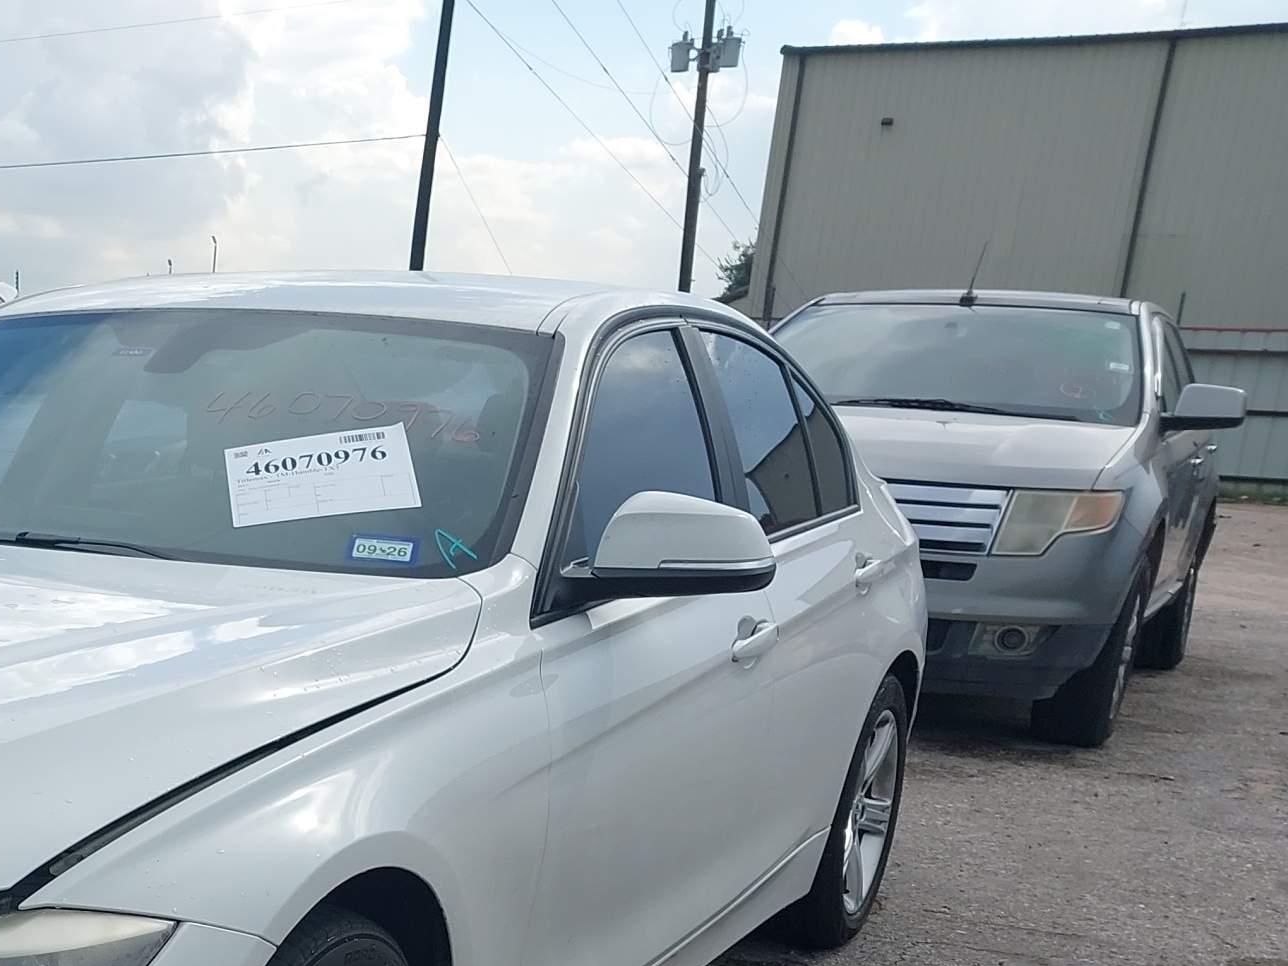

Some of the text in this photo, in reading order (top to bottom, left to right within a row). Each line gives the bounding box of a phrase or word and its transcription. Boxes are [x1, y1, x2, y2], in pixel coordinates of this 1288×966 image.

[245, 445, 388, 476] 46070976
[356, 543, 409, 558] 09 26
